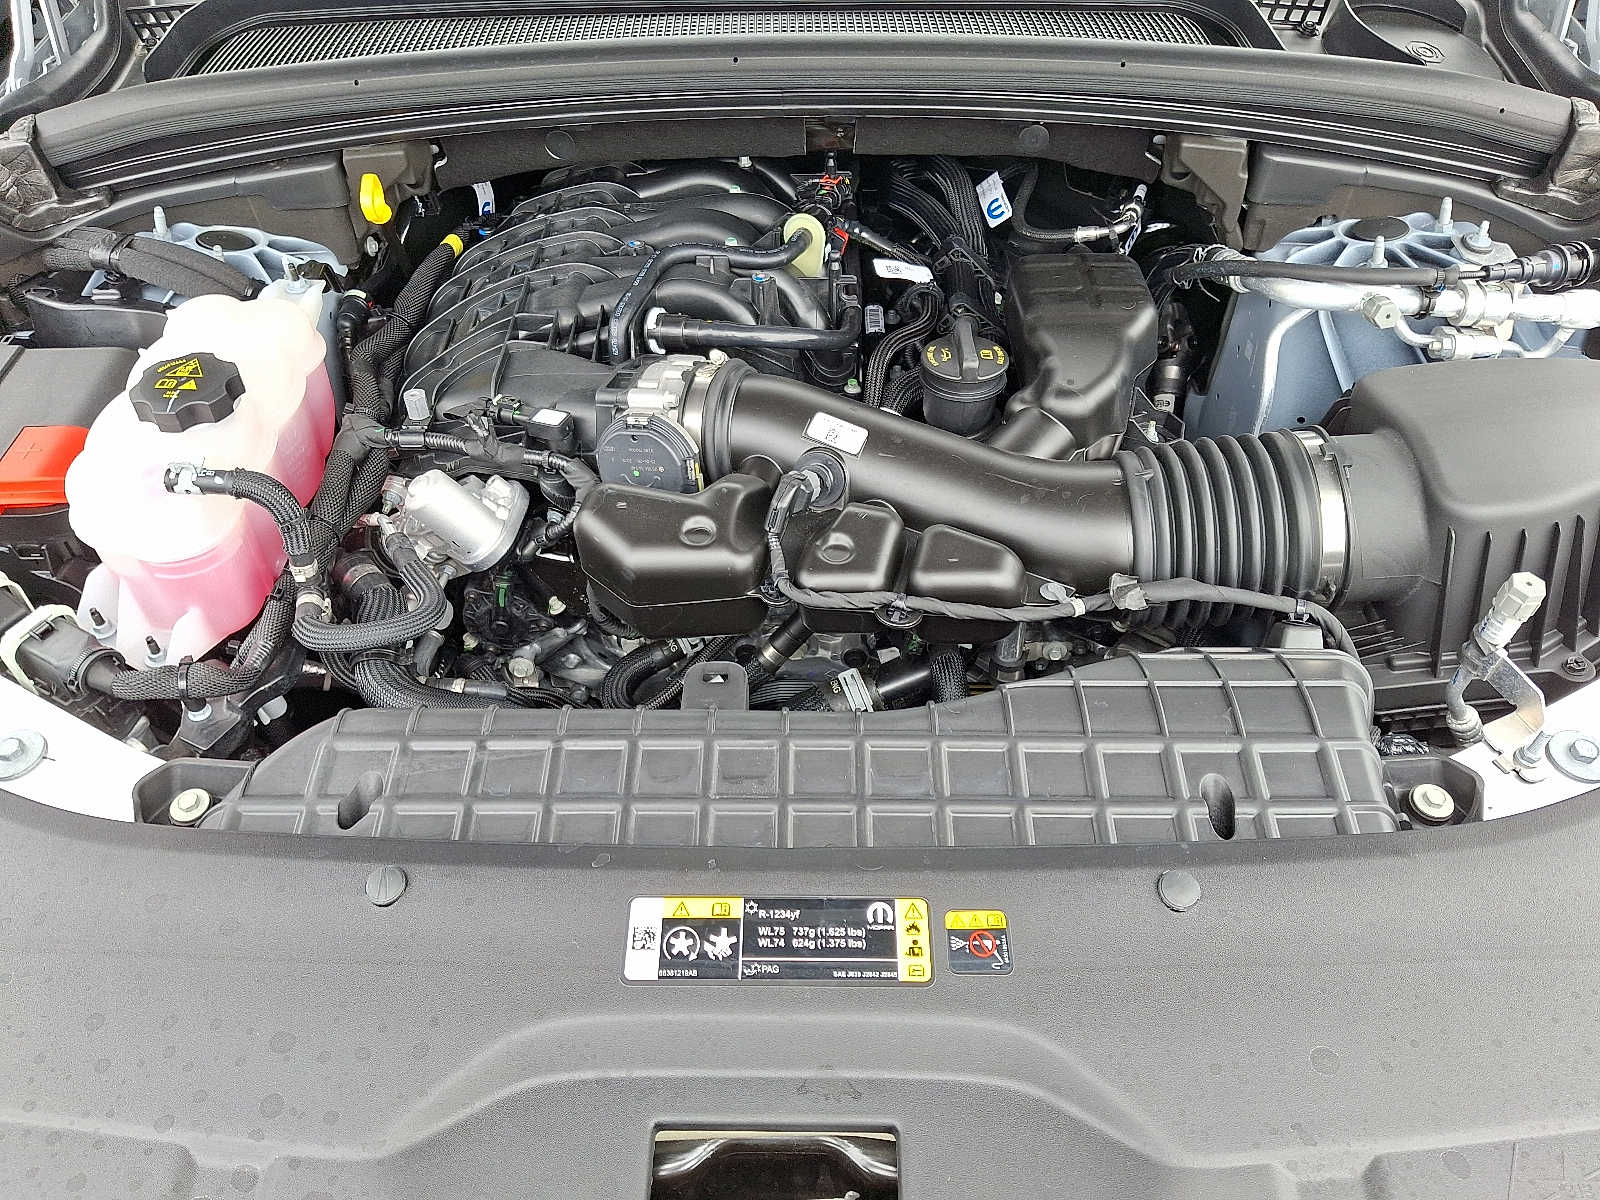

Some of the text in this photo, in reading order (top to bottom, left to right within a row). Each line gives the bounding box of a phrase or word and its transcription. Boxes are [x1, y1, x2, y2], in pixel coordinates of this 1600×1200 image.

[758, 909, 801, 921] R-1234yf
[757, 926, 866, 938] WL75 737g (1.625 lbs)
[757, 938, 867, 950] WL74 624g (1.375 lbs)
[761, 964, 780, 974] PAG
